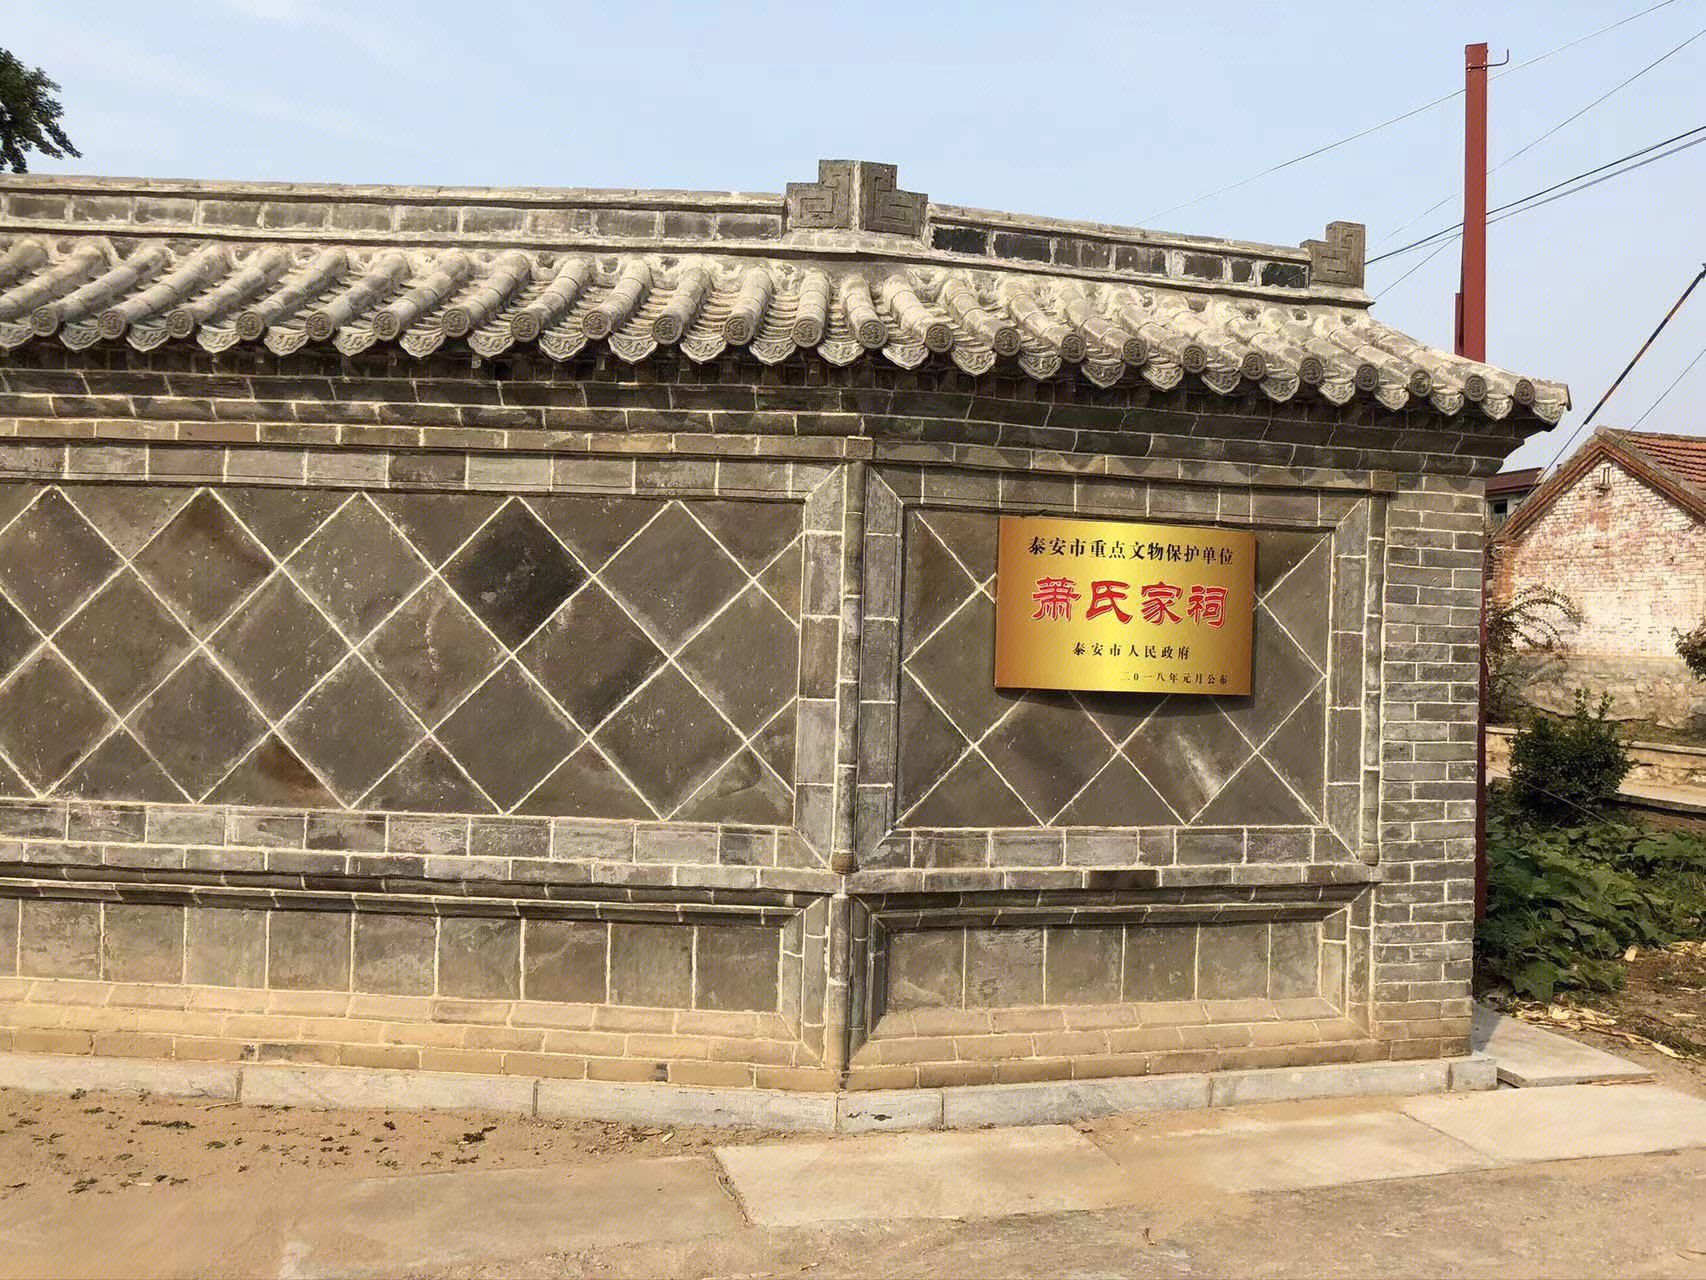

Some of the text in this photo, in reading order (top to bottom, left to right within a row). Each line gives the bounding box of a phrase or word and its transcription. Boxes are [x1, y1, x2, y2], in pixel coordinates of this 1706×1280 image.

[1028, 536, 1233, 565] 泰安市重点文物保护单位
[1072, 642, 1190, 660] 泰安市人民政府
